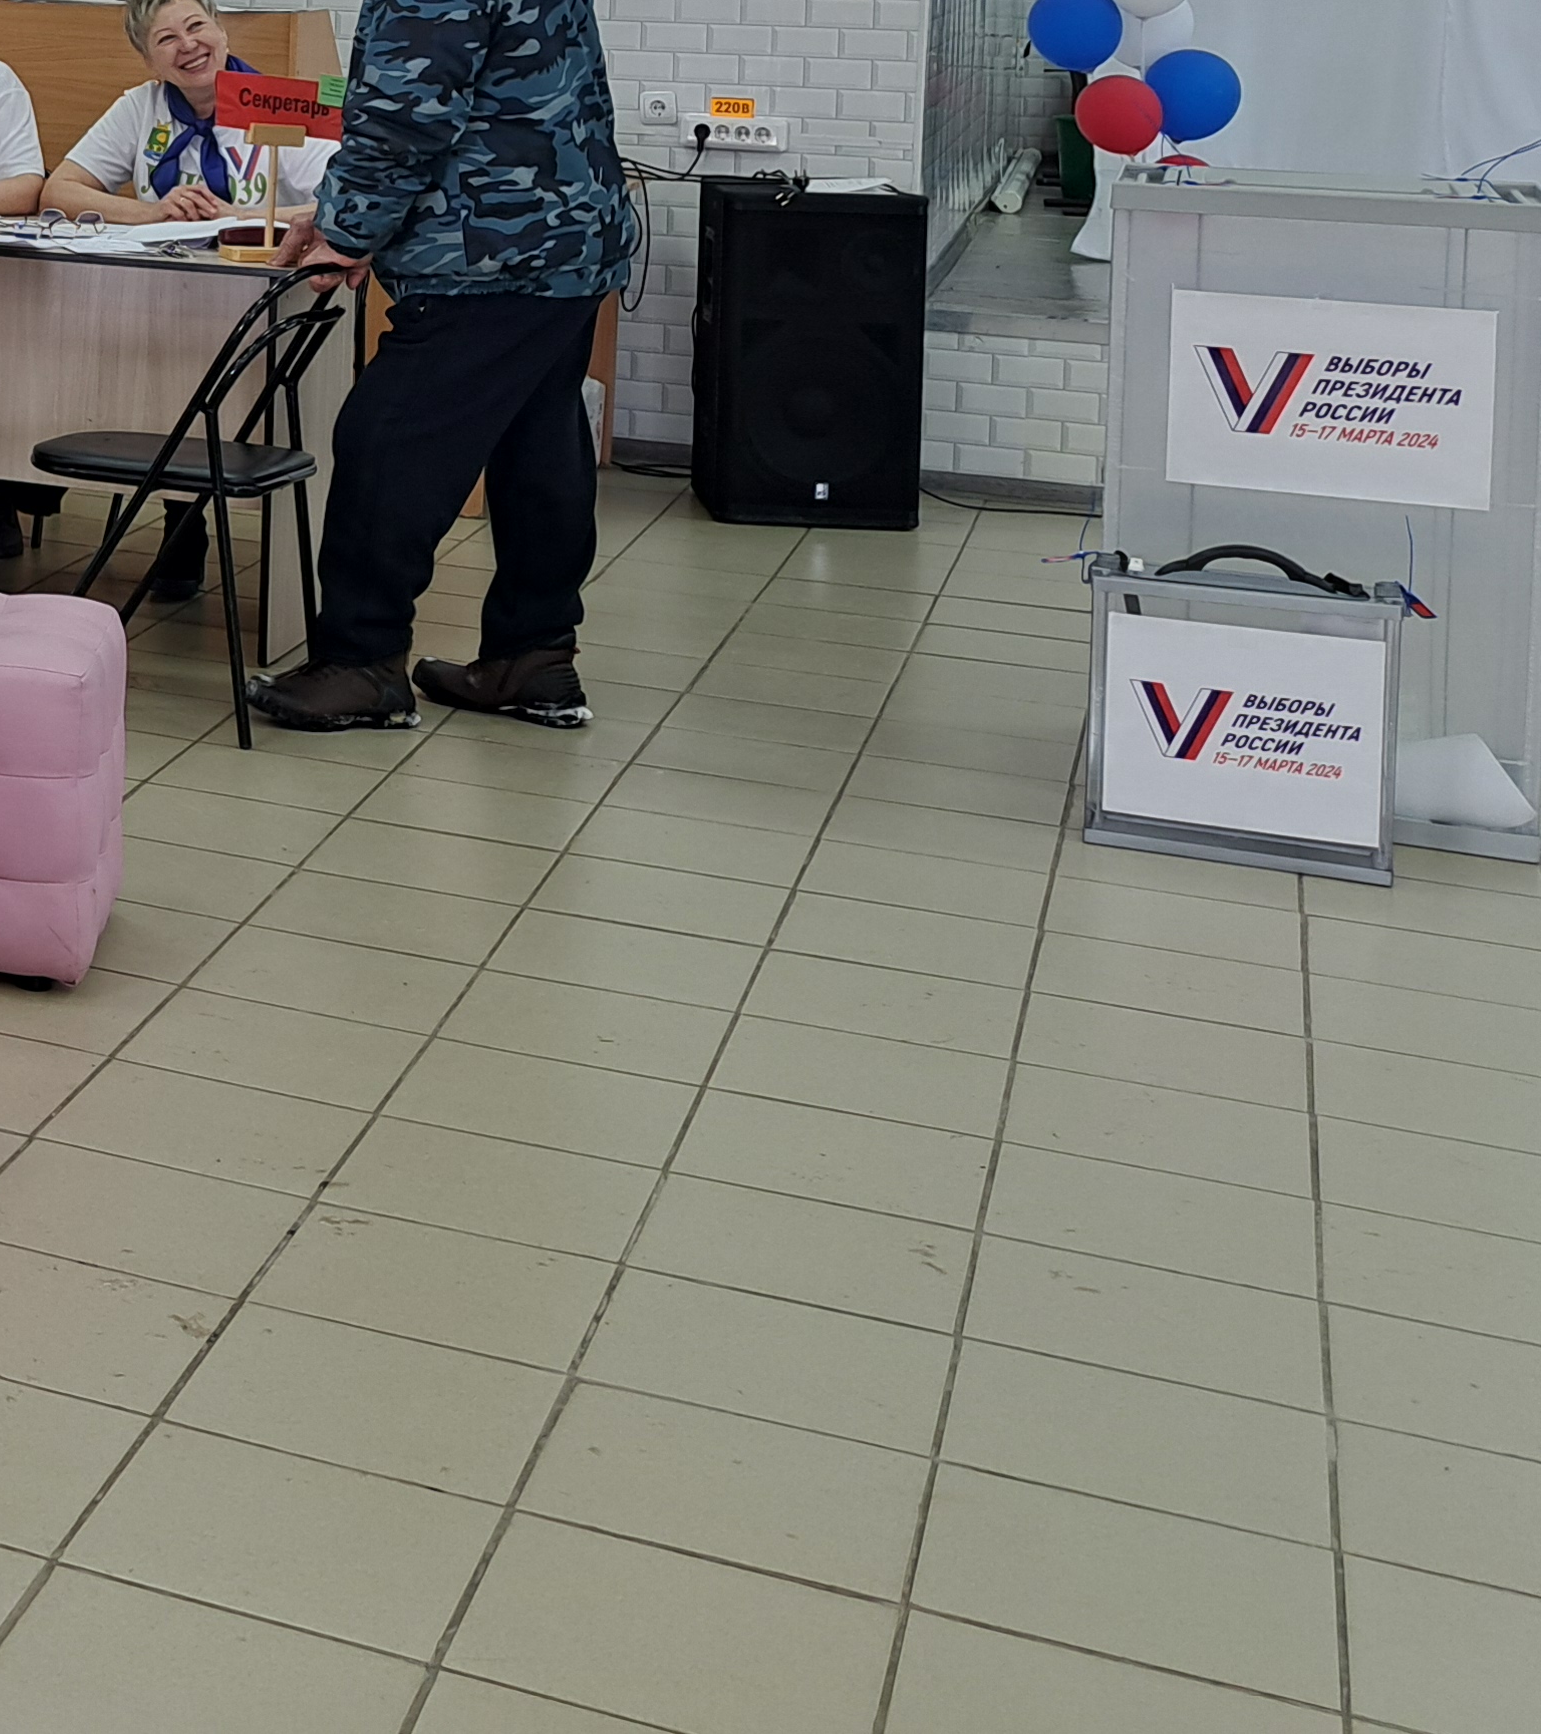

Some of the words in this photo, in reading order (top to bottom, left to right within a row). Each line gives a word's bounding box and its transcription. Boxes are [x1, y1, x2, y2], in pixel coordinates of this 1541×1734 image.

[239, 87, 330, 119] Секретарь
[1324, 355, 1433, 380] ВЫБОРЫ
[1311, 378, 1463, 406] ПРЕЗИДЕНТА
[1298, 400, 1397, 425] РОССИИ
[1336, 427, 1395, 446] МАРТА
[1396, 431, 1440, 450] 2024
[1242, 693, 1336, 718] ВЫБОРЫ
[1231, 713, 1362, 742] ПРЕЗИДЕНТА
[1220, 732, 1305, 756] РОССИИ
[1253, 756, 1304, 775] МАРТА
[1305, 762, 1343, 779] 2024
